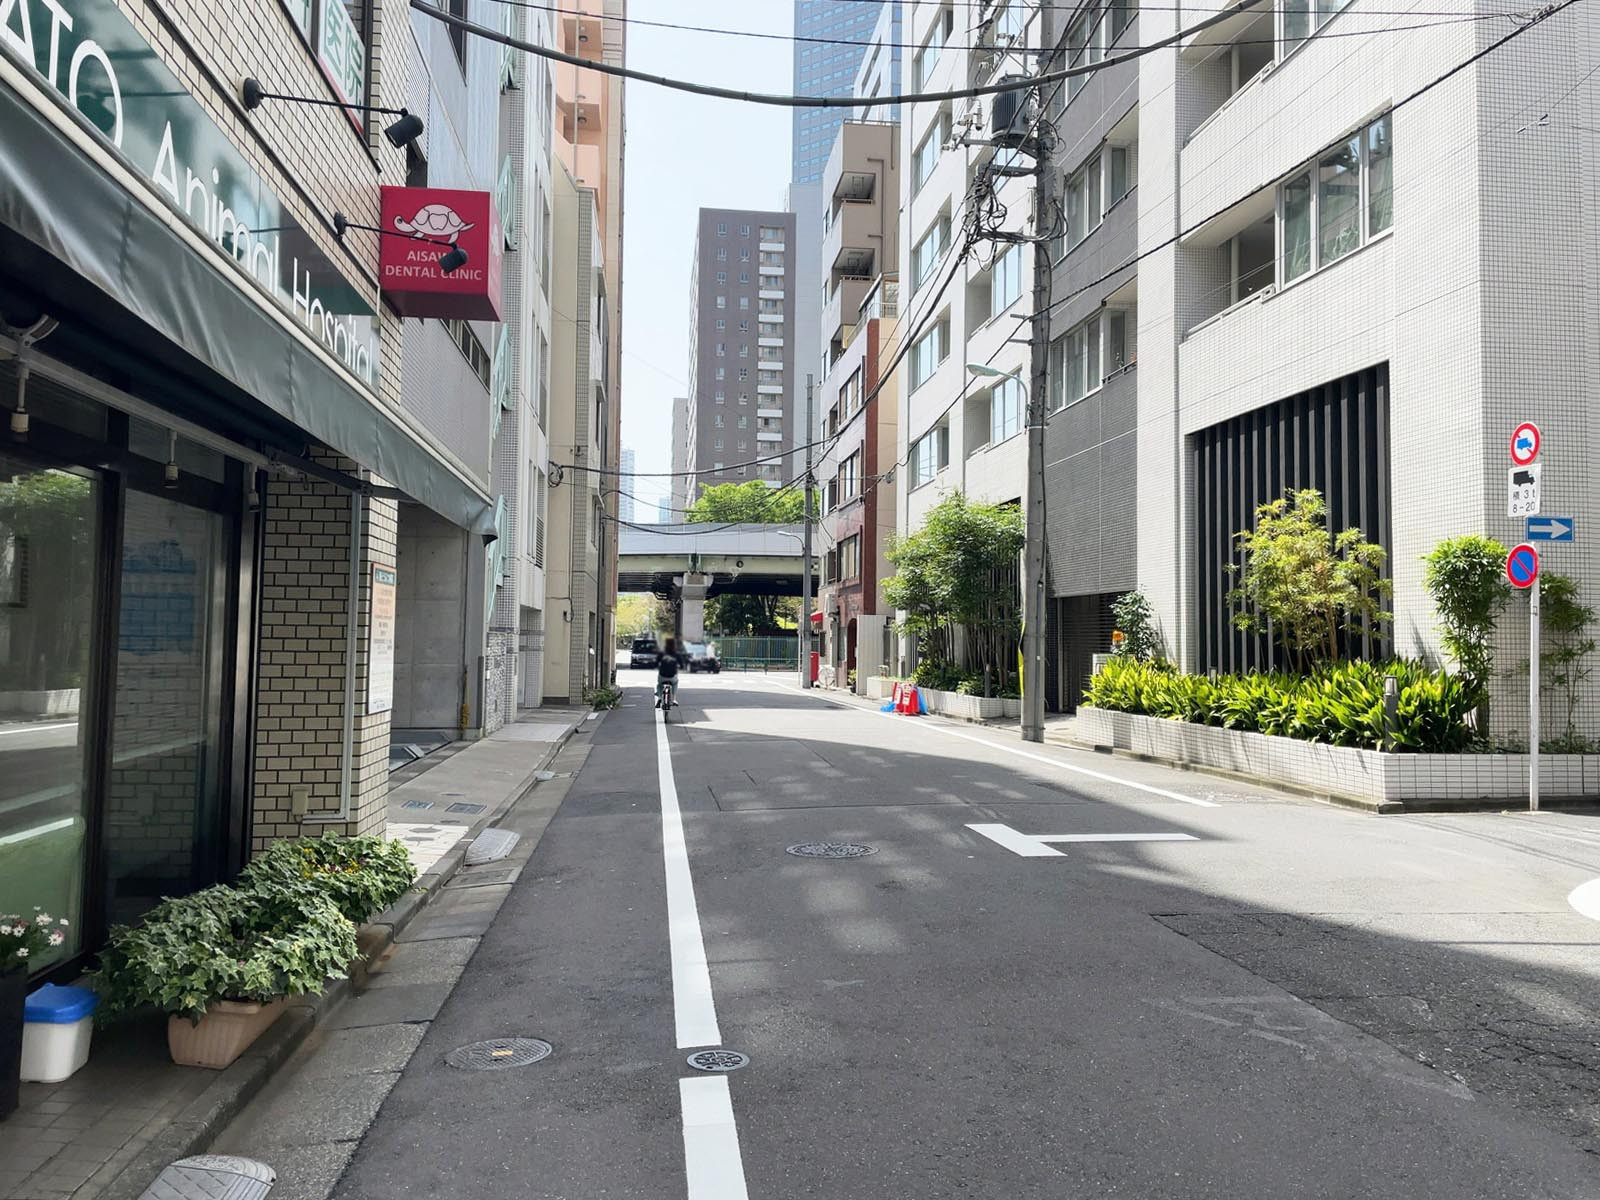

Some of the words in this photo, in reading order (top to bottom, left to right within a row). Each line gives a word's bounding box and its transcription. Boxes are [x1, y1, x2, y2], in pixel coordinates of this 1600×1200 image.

[152, 120, 280, 299] Animal
[292, 257, 373, 386] Hospital
[385, 265, 437, 278] DENTAL
[440, 268, 482, 281] CLINIC
[1512, 501, 1536, 513] 8-20
